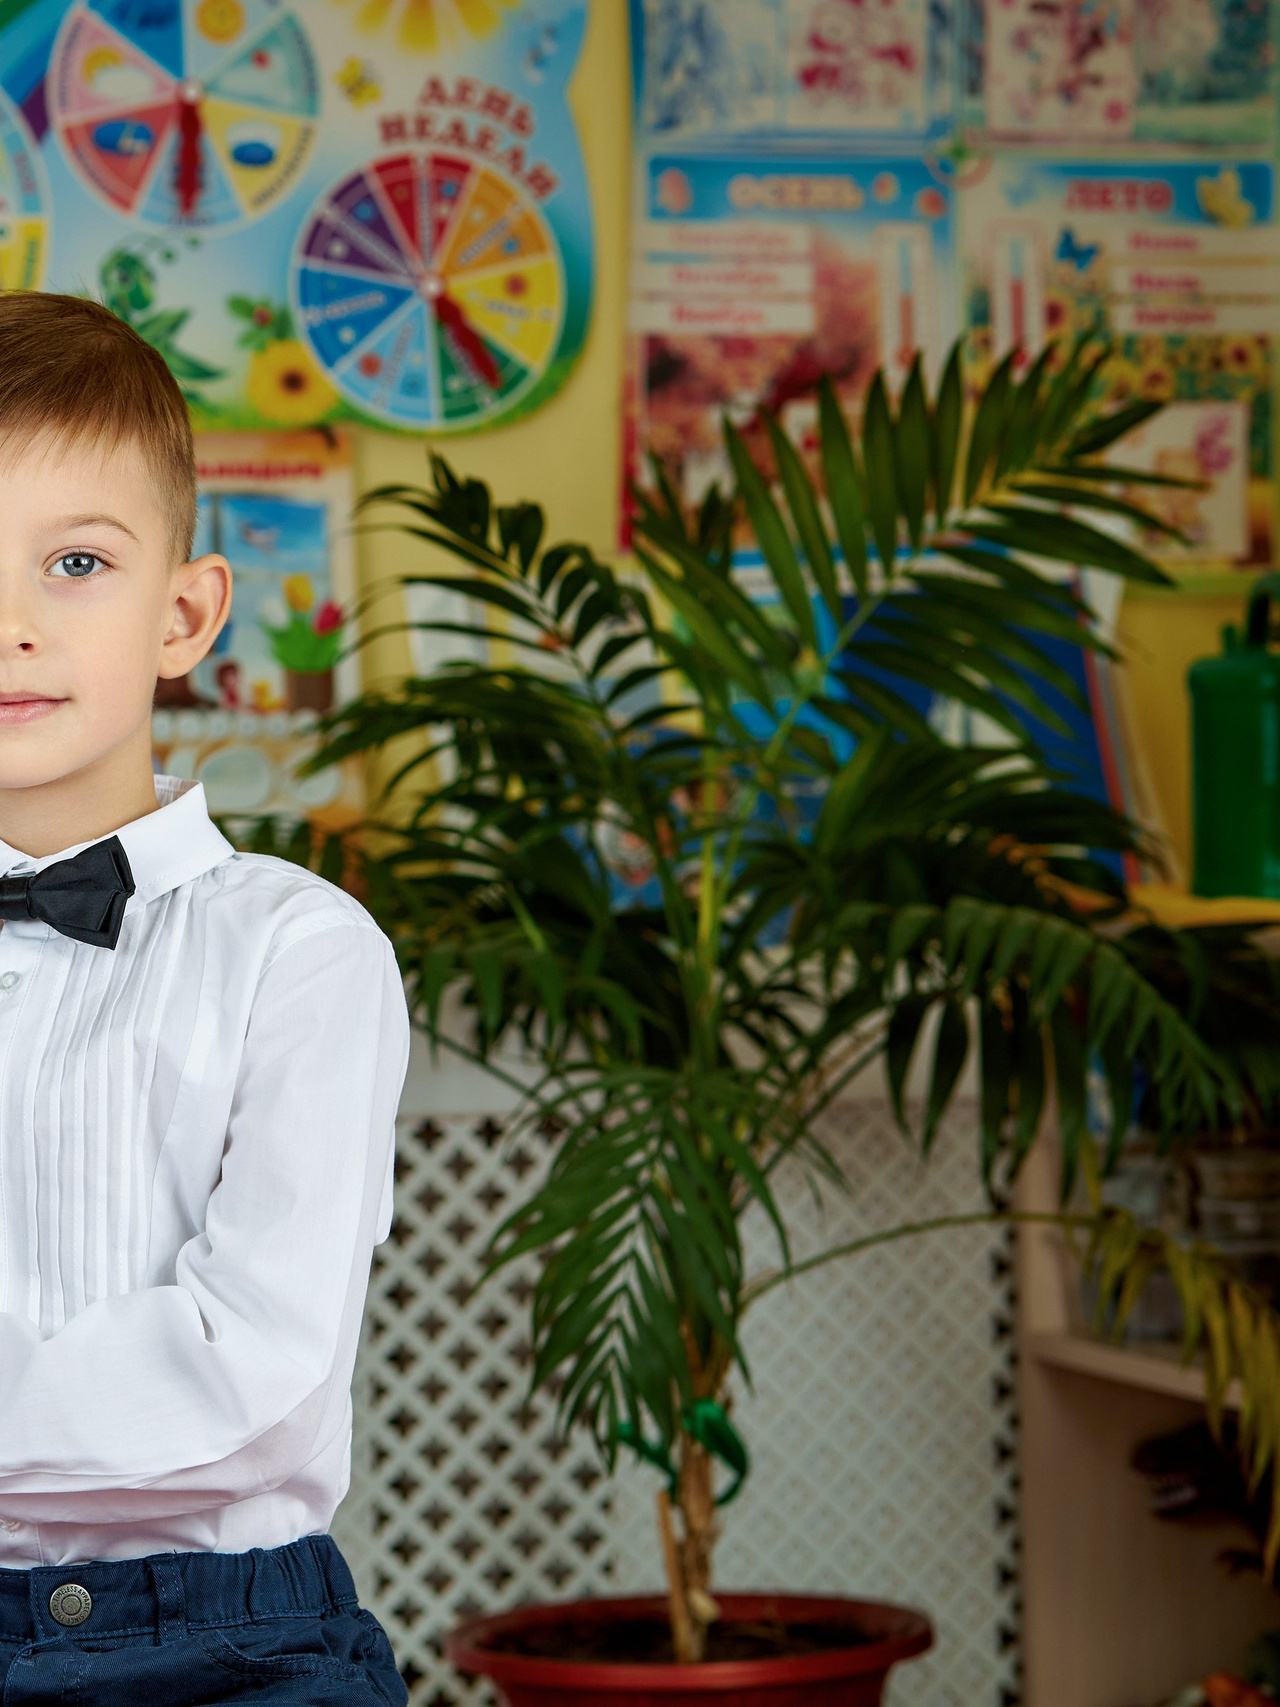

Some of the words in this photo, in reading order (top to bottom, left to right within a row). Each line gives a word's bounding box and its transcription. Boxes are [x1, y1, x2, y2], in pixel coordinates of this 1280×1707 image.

[419, 75, 534, 136] ДЕНЬ
[379, 111, 559, 199] НЕДЕЛИ
[1063, 180, 1174, 213] ЛЕТО
[53, 1586, 77, 1602] TIMELESS
[78, 1589, 90, 1613] APPAREL
[67, 1614, 85, 1624] SINCE
